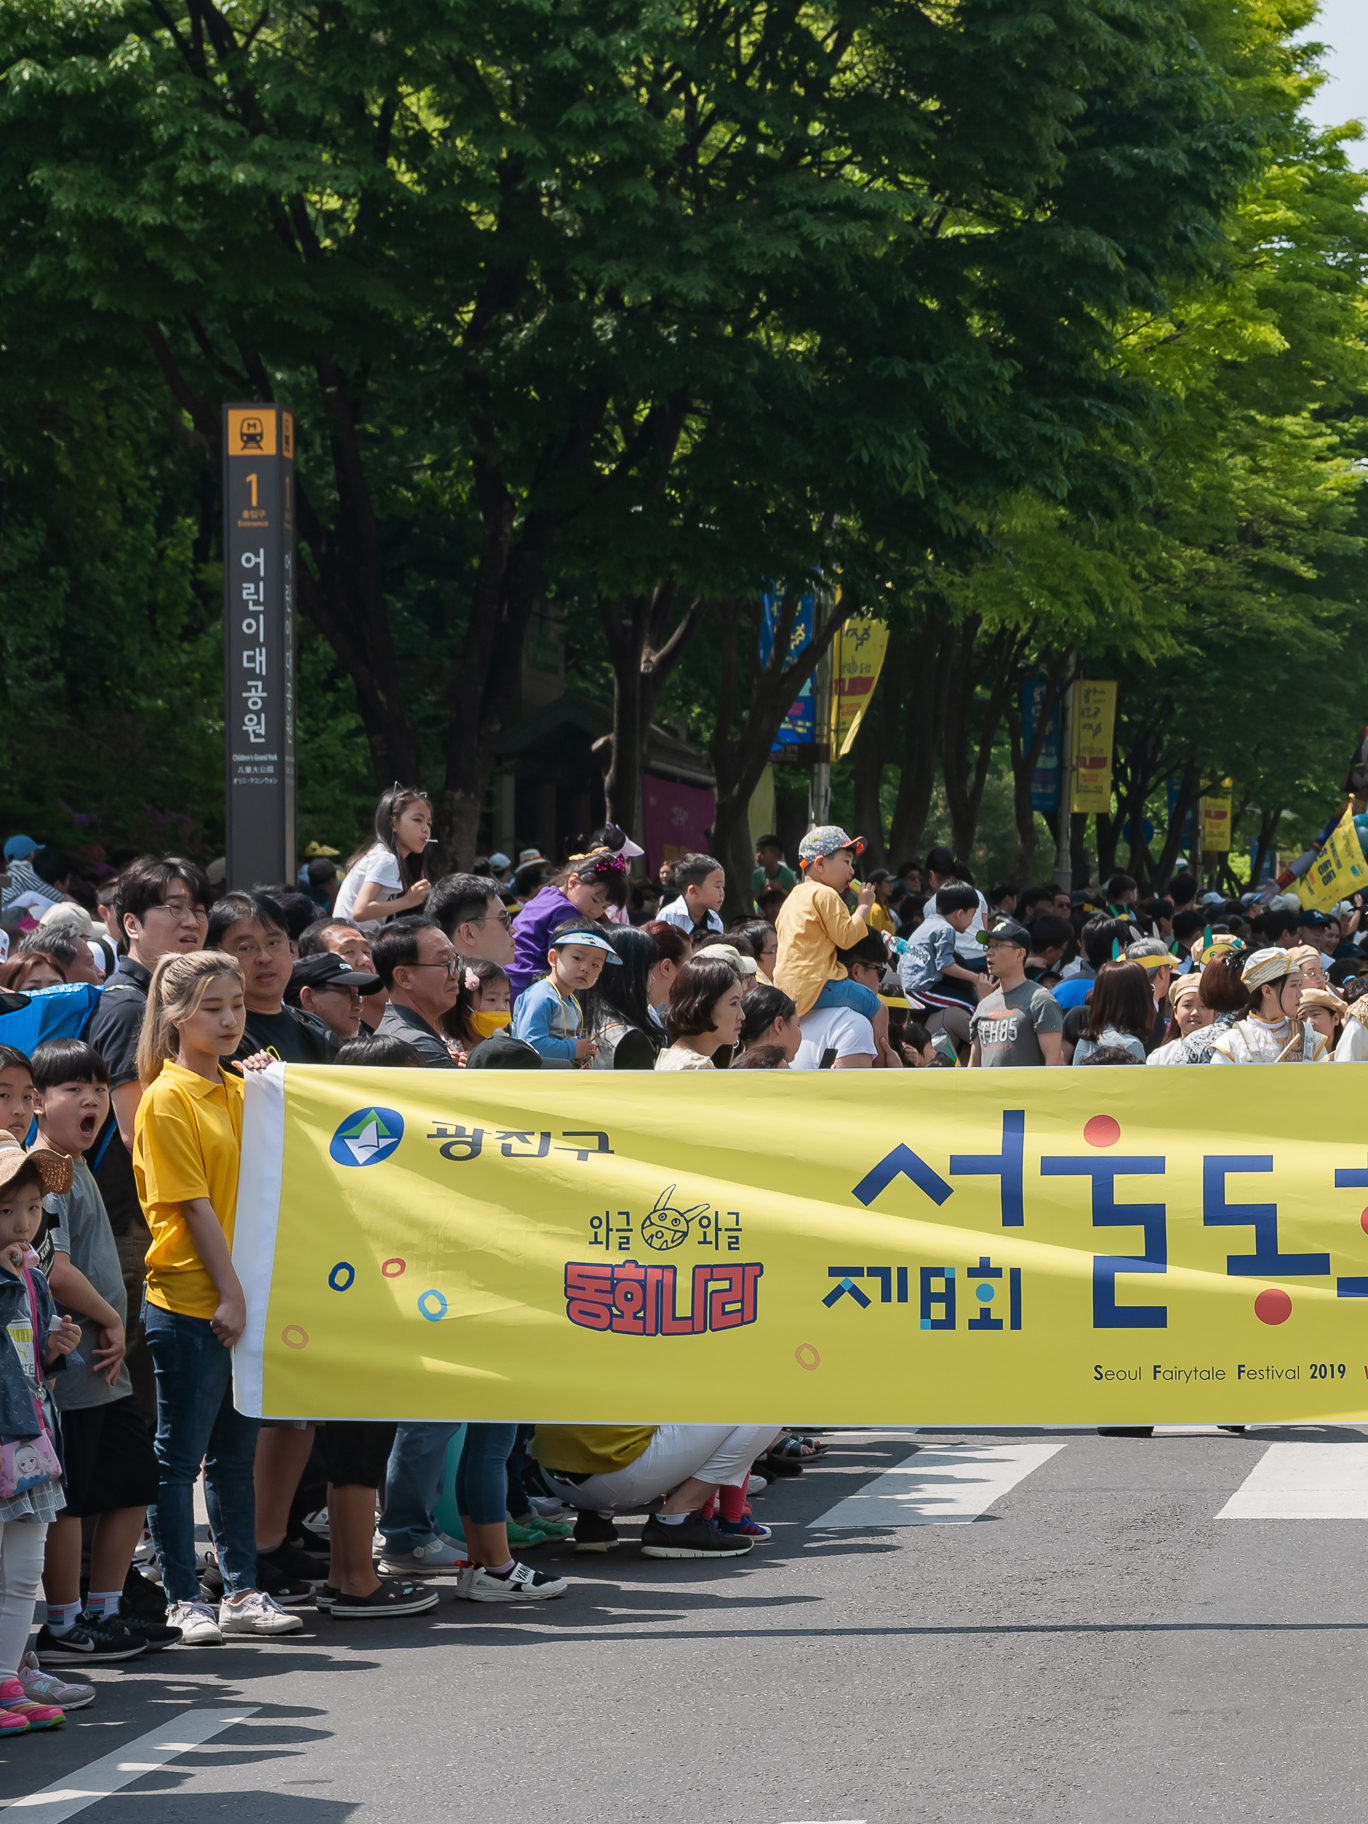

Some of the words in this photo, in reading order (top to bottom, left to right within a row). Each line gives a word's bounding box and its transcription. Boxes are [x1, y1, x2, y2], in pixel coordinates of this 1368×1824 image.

[246, 473, 258, 507] 1
[241, 548, 268, 743] 어린이대공원
[427, 1121, 615, 1162] 광진구
[588, 1211, 633, 1251] 와글
[698, 1211, 743, 1251] 와글
[564, 1259, 764, 1337] 동화나라
[822, 1257, 1022, 1331] 제8회
[1093, 1364, 1142, 1381] Seoul
[1153, 1364, 1226, 1384] Fairytale
[1237, 1364, 1300, 1381] Festival
[1309, 1363, 1347, 1380] 2019
